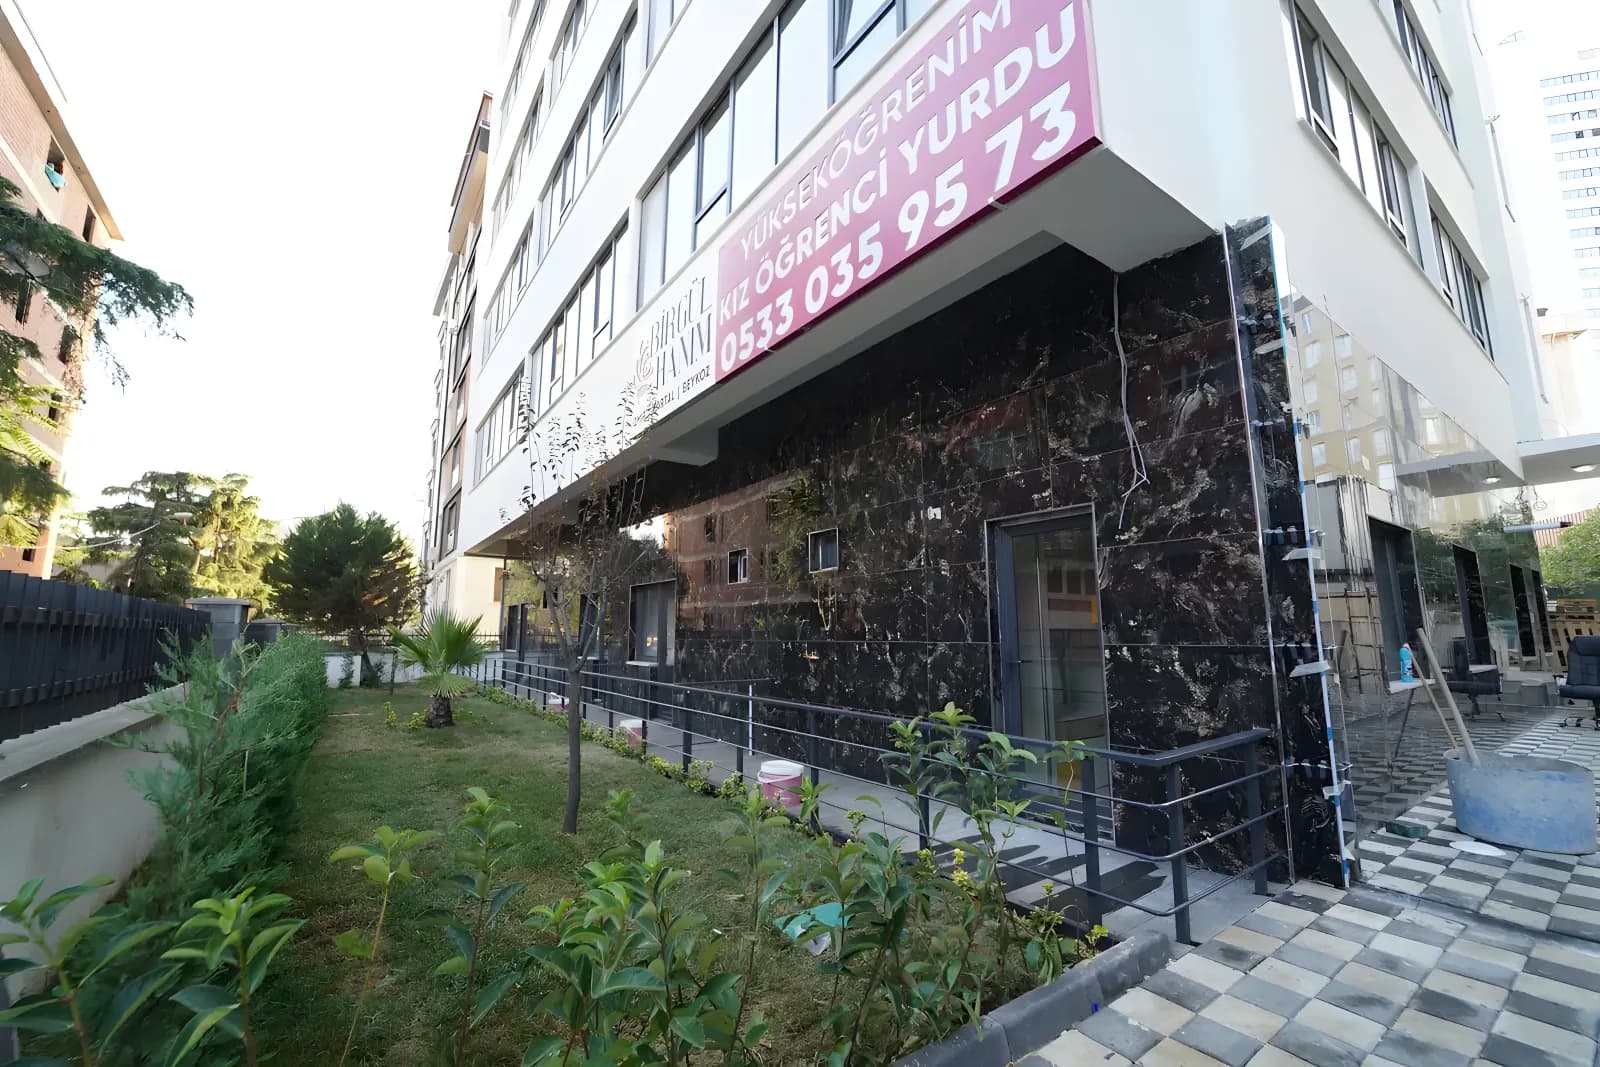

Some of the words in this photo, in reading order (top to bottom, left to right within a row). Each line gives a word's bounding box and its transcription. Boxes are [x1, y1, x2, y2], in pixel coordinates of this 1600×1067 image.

[719, 277, 750, 326] KIZ
[755, 147, 888, 295] ÖĞRENCİ
[898, 1, 1076, 175] YURDU
[720, 288, 794, 372] 0533
[805, 220, 884, 314] 035
[898, 158, 968, 252] 95
[984, 80, 1077, 193] 73
[682, 364, 711, 394] BEYKOZ
